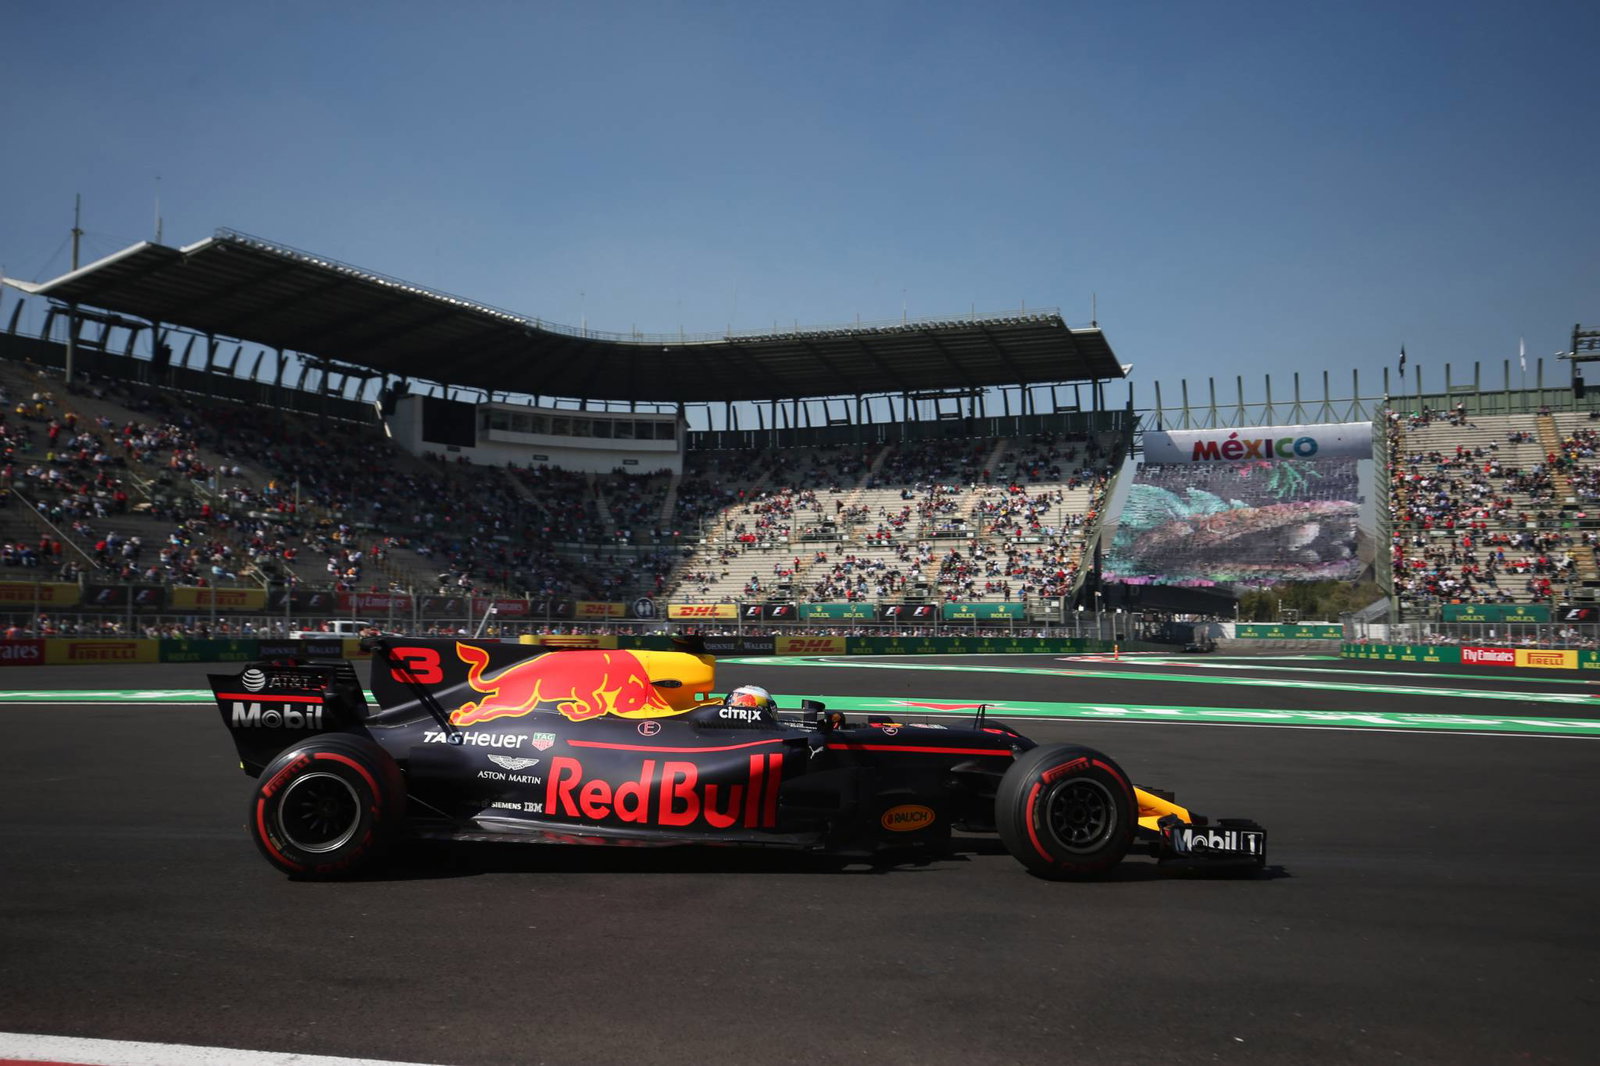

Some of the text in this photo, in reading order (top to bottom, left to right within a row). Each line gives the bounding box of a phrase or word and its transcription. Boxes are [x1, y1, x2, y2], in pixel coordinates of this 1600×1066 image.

[679, 606, 720, 616] DHL
[69, 642, 137, 659] PIRELLI
[788, 639, 834, 651] DHL
[1463, 649, 1513, 662] Fly Emirates
[1528, 652, 1564, 666] PIRELLI
[389, 647, 443, 684] 3
[231, 701, 324, 730] Mobil
[477, 770, 542, 785] ASTON MARTIN
[545, 753, 784, 829] Red Bull
[491, 801, 543, 813] SIEMENS IBM
[894, 812, 928, 824] RAUCH
[1173, 828, 1237, 852] Mobil
